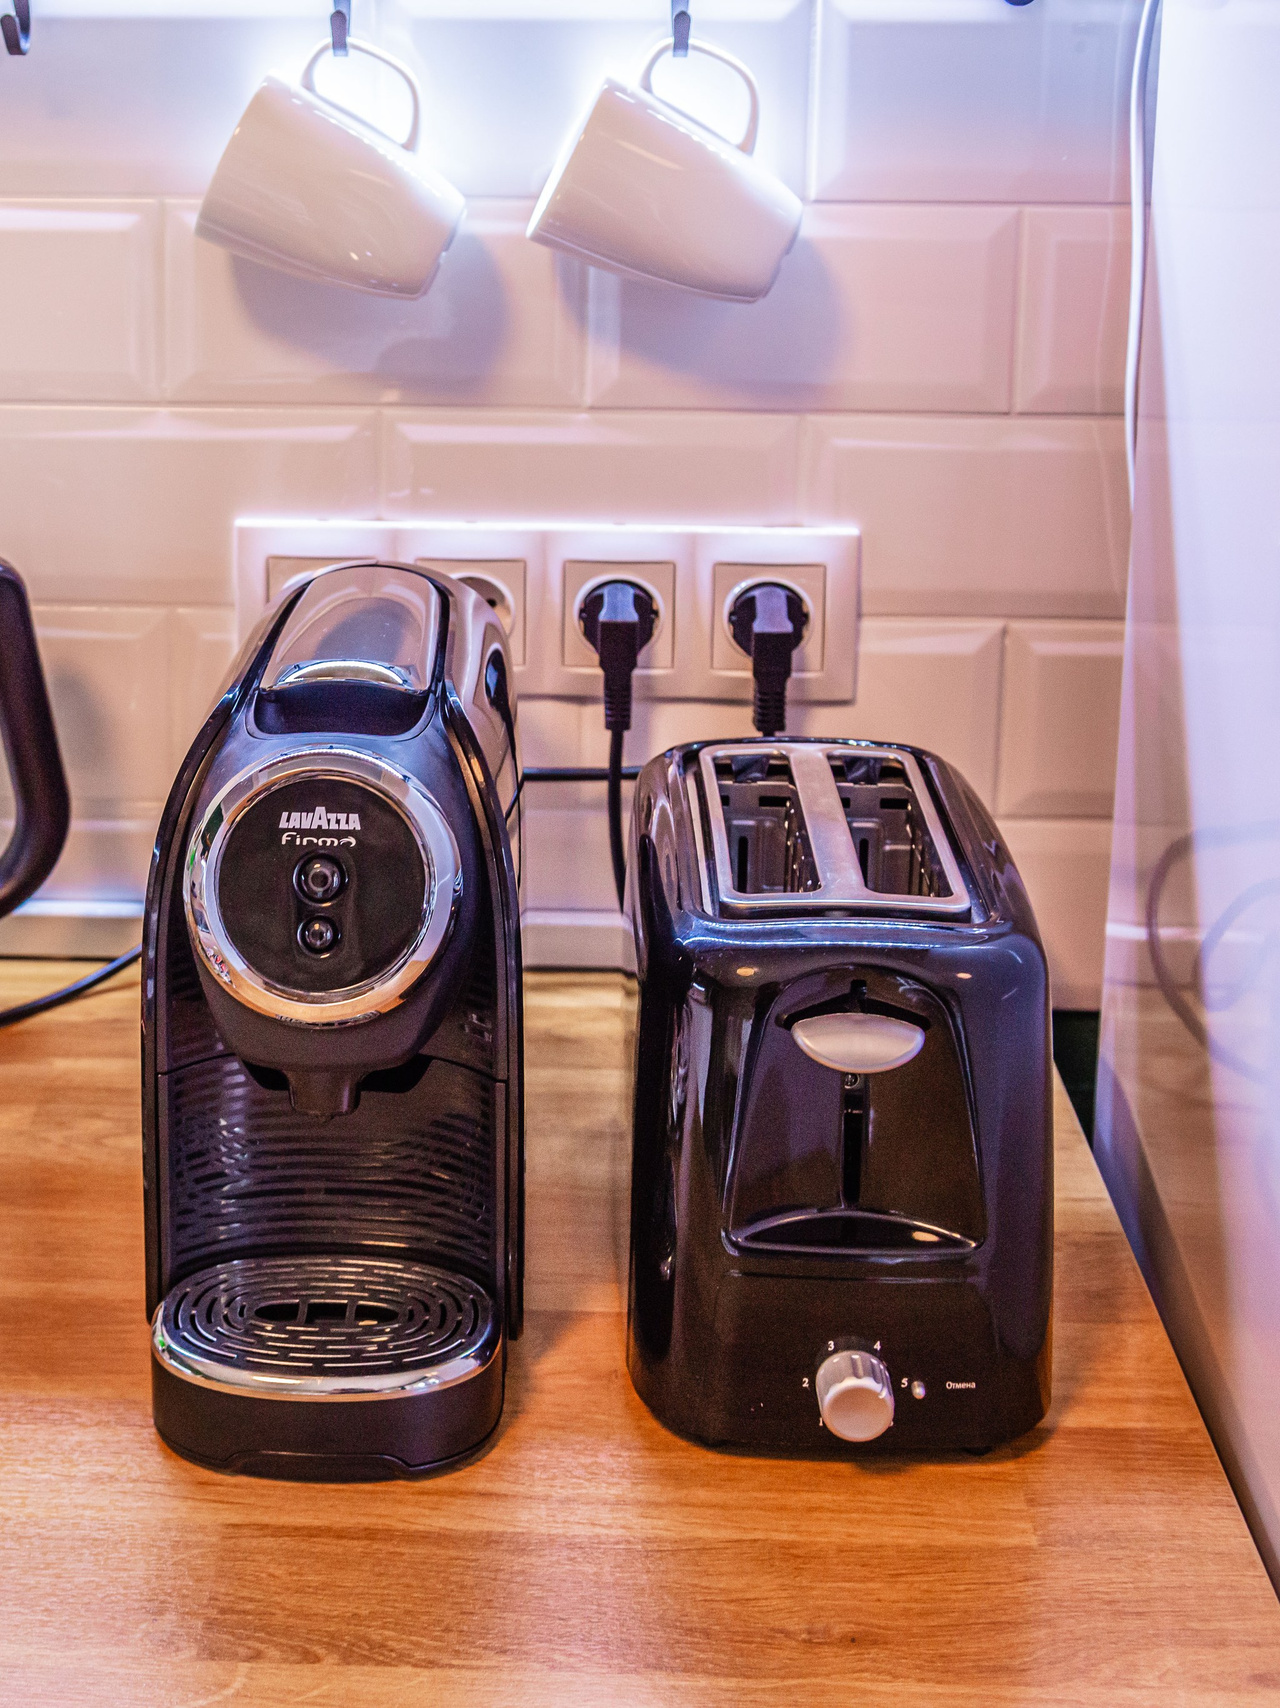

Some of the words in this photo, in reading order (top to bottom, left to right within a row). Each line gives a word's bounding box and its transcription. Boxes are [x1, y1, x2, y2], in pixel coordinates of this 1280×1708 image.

[278, 806, 361, 830] LAVAZZA
[827, 1341, 835, 1351] 3
[873, 1341, 882, 1351] 4
[802, 1378, 809, 1388] 2
[901, 1378, 909, 1388] 5
[945, 1381, 977, 1390] Отмена
